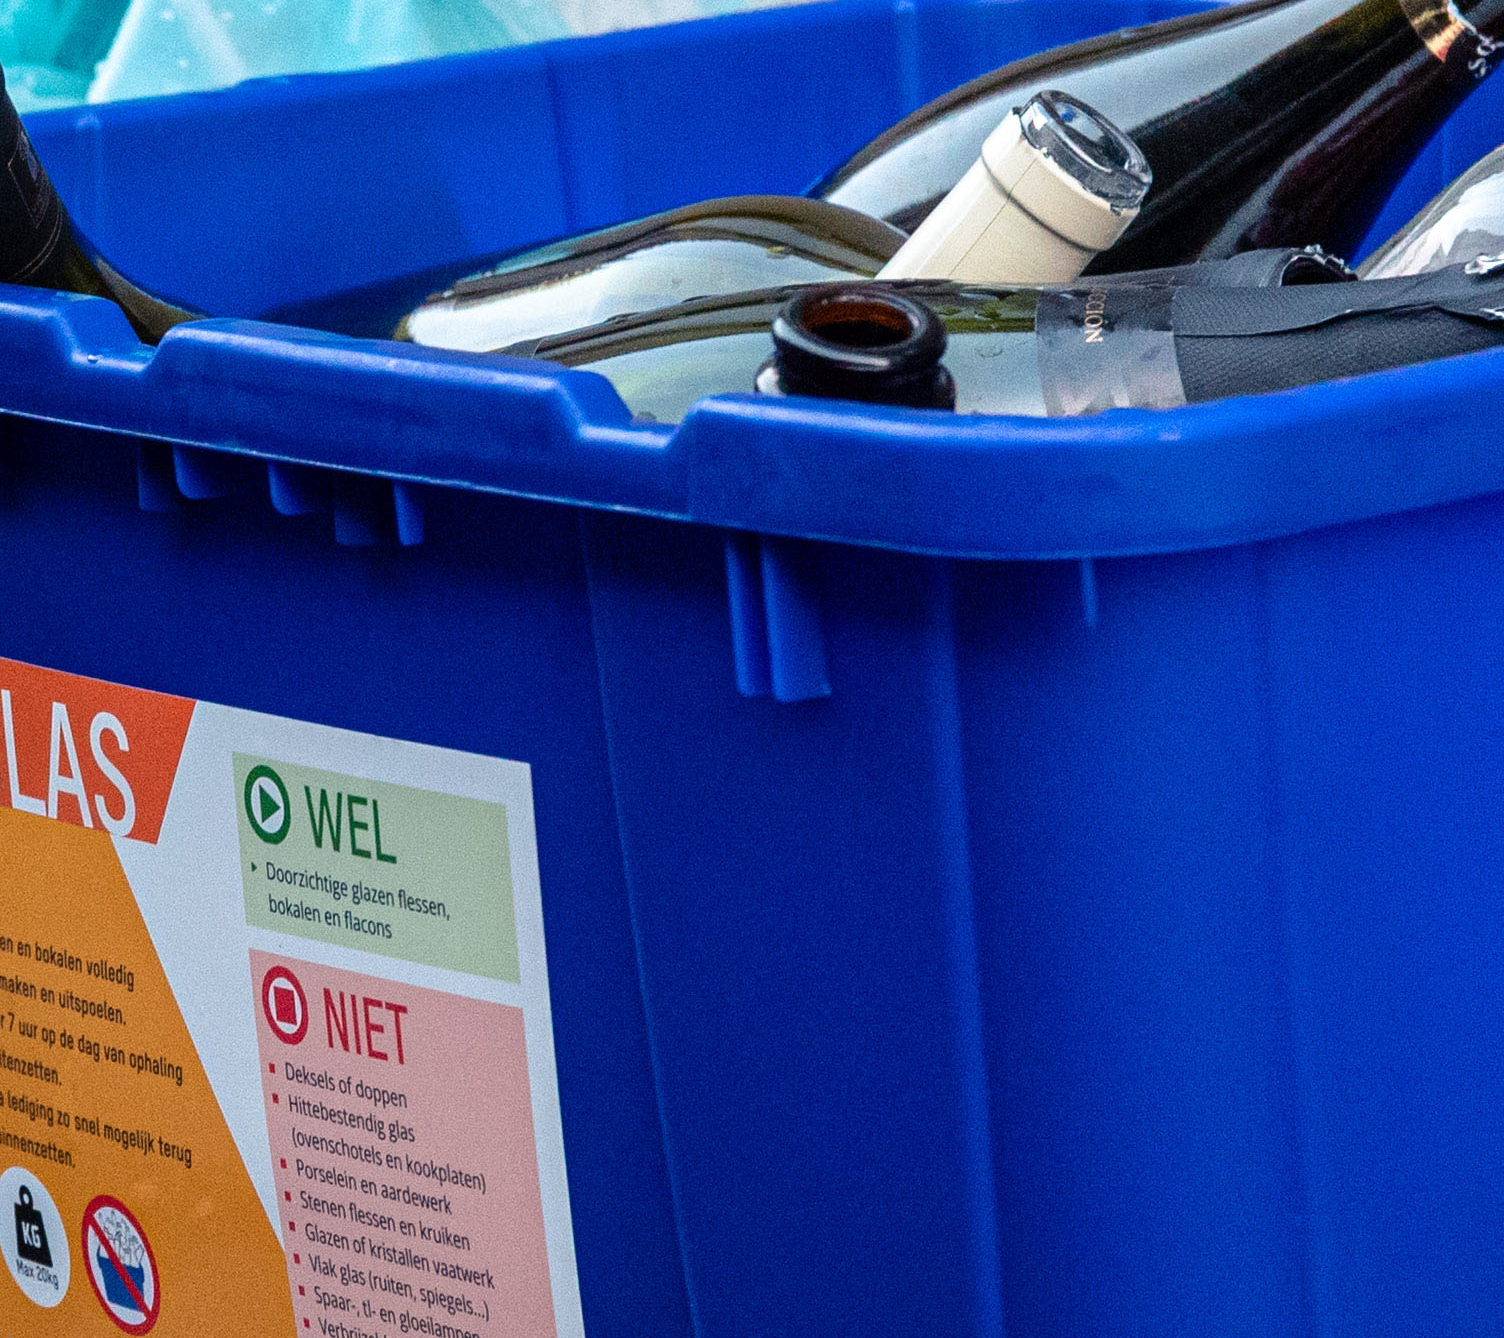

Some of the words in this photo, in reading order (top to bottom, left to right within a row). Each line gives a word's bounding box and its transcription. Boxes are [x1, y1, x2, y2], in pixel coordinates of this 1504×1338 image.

[304, 785, 397, 864] WEL
[266, 862, 348, 900] Doorzichtige
[352, 882, 394, 907] glazen
[398, 889, 450, 921] flessen,
[269, 894, 320, 923] bokalen
[325, 909, 341, 927] en
[344, 912, 392, 939] flacons
[17, 940, 31, 958] en
[35, 941, 82, 973] bokalen
[87, 959, 134, 991] volledig
[41, 987, 55, 1004] en
[59, 992, 126, 1025] uitspoelen.
[323, 988, 408, 1065] NIET
[8, 1013, 15, 1032] 7
[19, 1021, 38, 1039] uur
[42, 1028, 56, 1049] op
[60, 1030, 74, 1050] de
[78, 1035, 100, 1062] dag
[104, 1045, 125, 1065] van
[129, 1052, 183, 1086] ophaling
[285, 1062, 335, 1091] Deksels
[339, 1077, 352, 1093] of
[356, 1080, 407, 1109] doppen
[7, 1089, 54, 1127] lediging
[57, 1110, 70, 1127] zo
[75, 1114, 100, 1137] snel
[104, 1124, 154, 1156] mogelijk
[158, 1137, 192, 1169] terug
[288, 1094, 386, 1140] Hittebestendig
[389, 1120, 415, 1143] glas
[292, 1127, 382, 1166] (ovenschotels
[386, 1154, 402, 1170] en
[406, 1154, 486, 1195] kookplaten)
[296, 1159, 357, 1190] Porselein
[361, 1179, 377, 1196] en
[381, 1184, 452, 1214] aardewerk
[21, 1221, 41, 1249] KG
[300, 1191, 346, 1216] Stenen
[350, 1202, 396, 1231] flessen
[400, 1219, 416, 1237] en
[420, 1221, 470, 1251] kruiken
[16, 1258, 35, 1278] Max
[36, 1264, 59, 1290] 20kg
[305, 1223, 349, 1250] Glazen
[353, 1236, 365, 1254] of
[369, 1239, 430, 1272] kristallen
[433, 1260, 495, 1289] vaatwerk
[308, 1254, 337, 1277] Vlak
[340, 1263, 366, 1286] glas
[369, 1271, 417, 1302] (ruiten,
[380, 1308, 396, 1325] en
